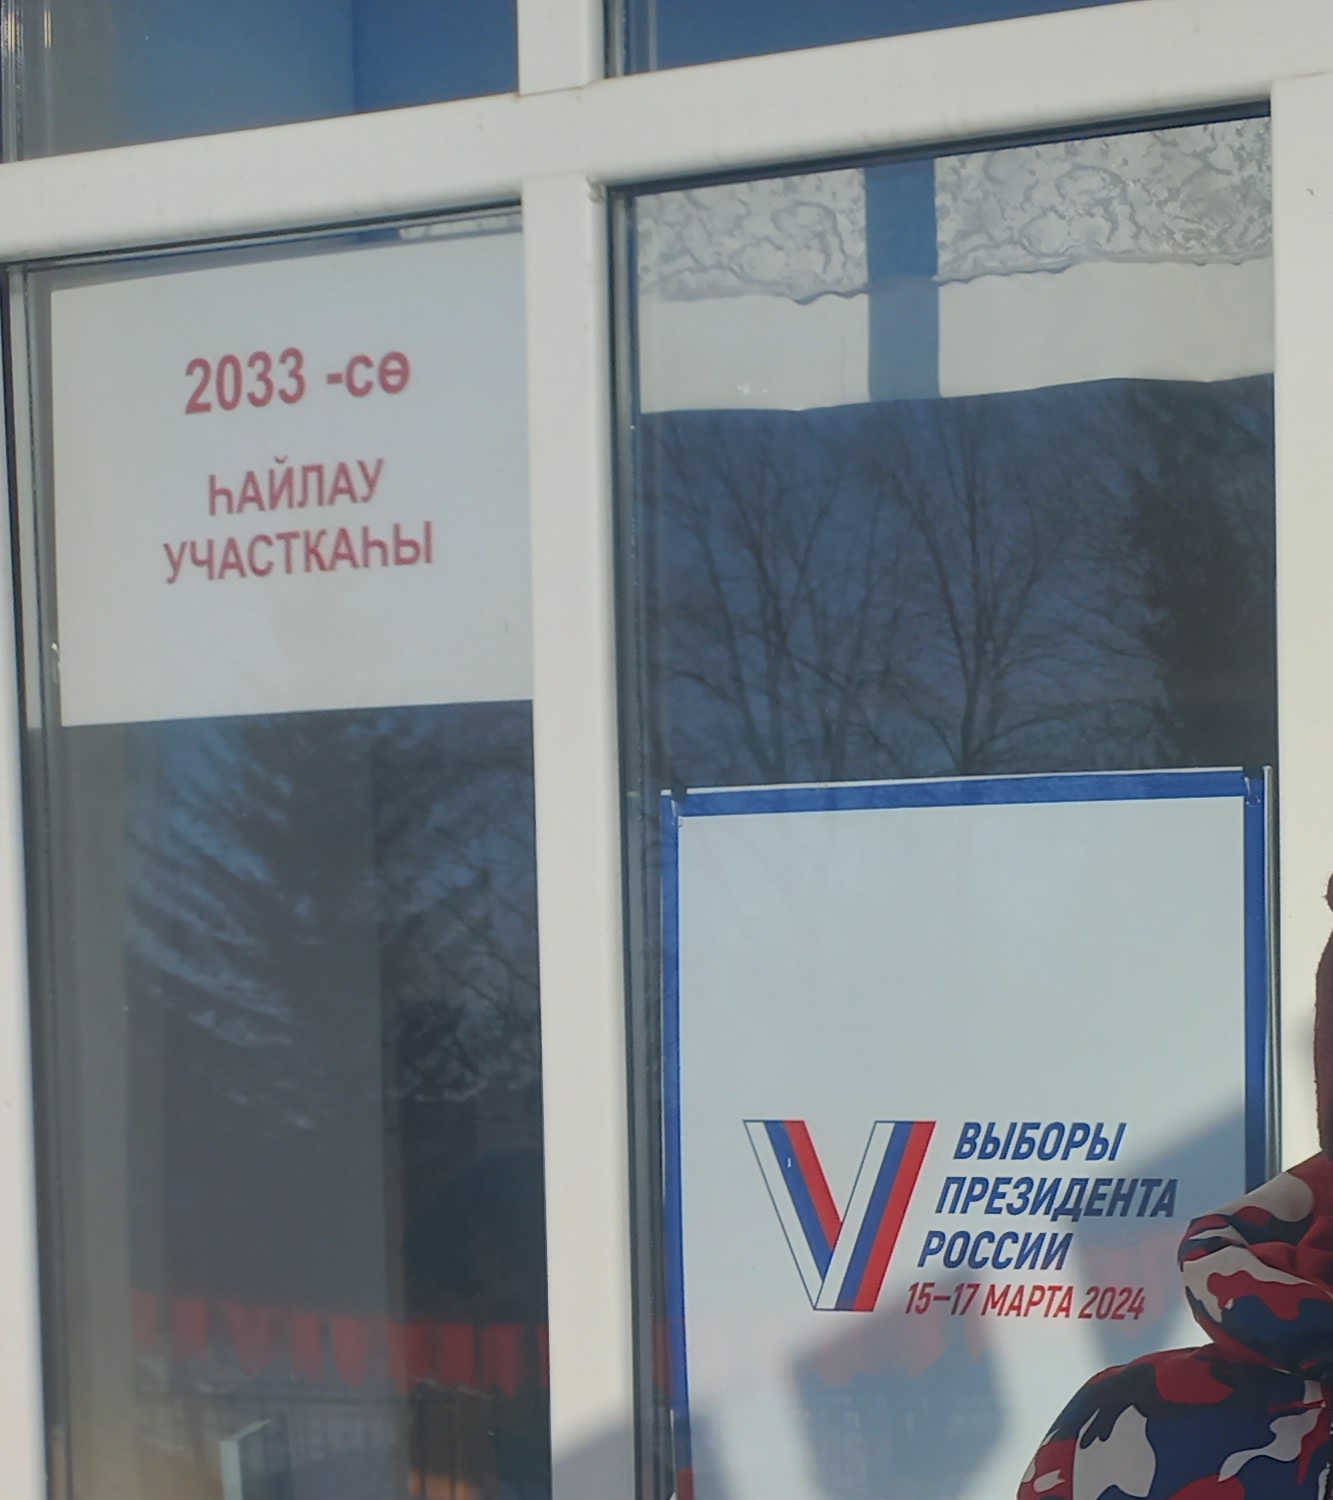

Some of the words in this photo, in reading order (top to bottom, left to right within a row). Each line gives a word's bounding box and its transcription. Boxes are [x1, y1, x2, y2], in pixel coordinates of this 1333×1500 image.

[185, 347, 305, 414] 2033
[953, 1123, 1126, 1162] ВЫБОРЫ
[935, 1177, 1178, 1221] ПРЕЗИДЕНТА
[917, 1231, 1073, 1270] РОССИИ
[981, 1284, 1073, 1319] МАРТА
[1078, 1286, 1145, 1321] 2024
